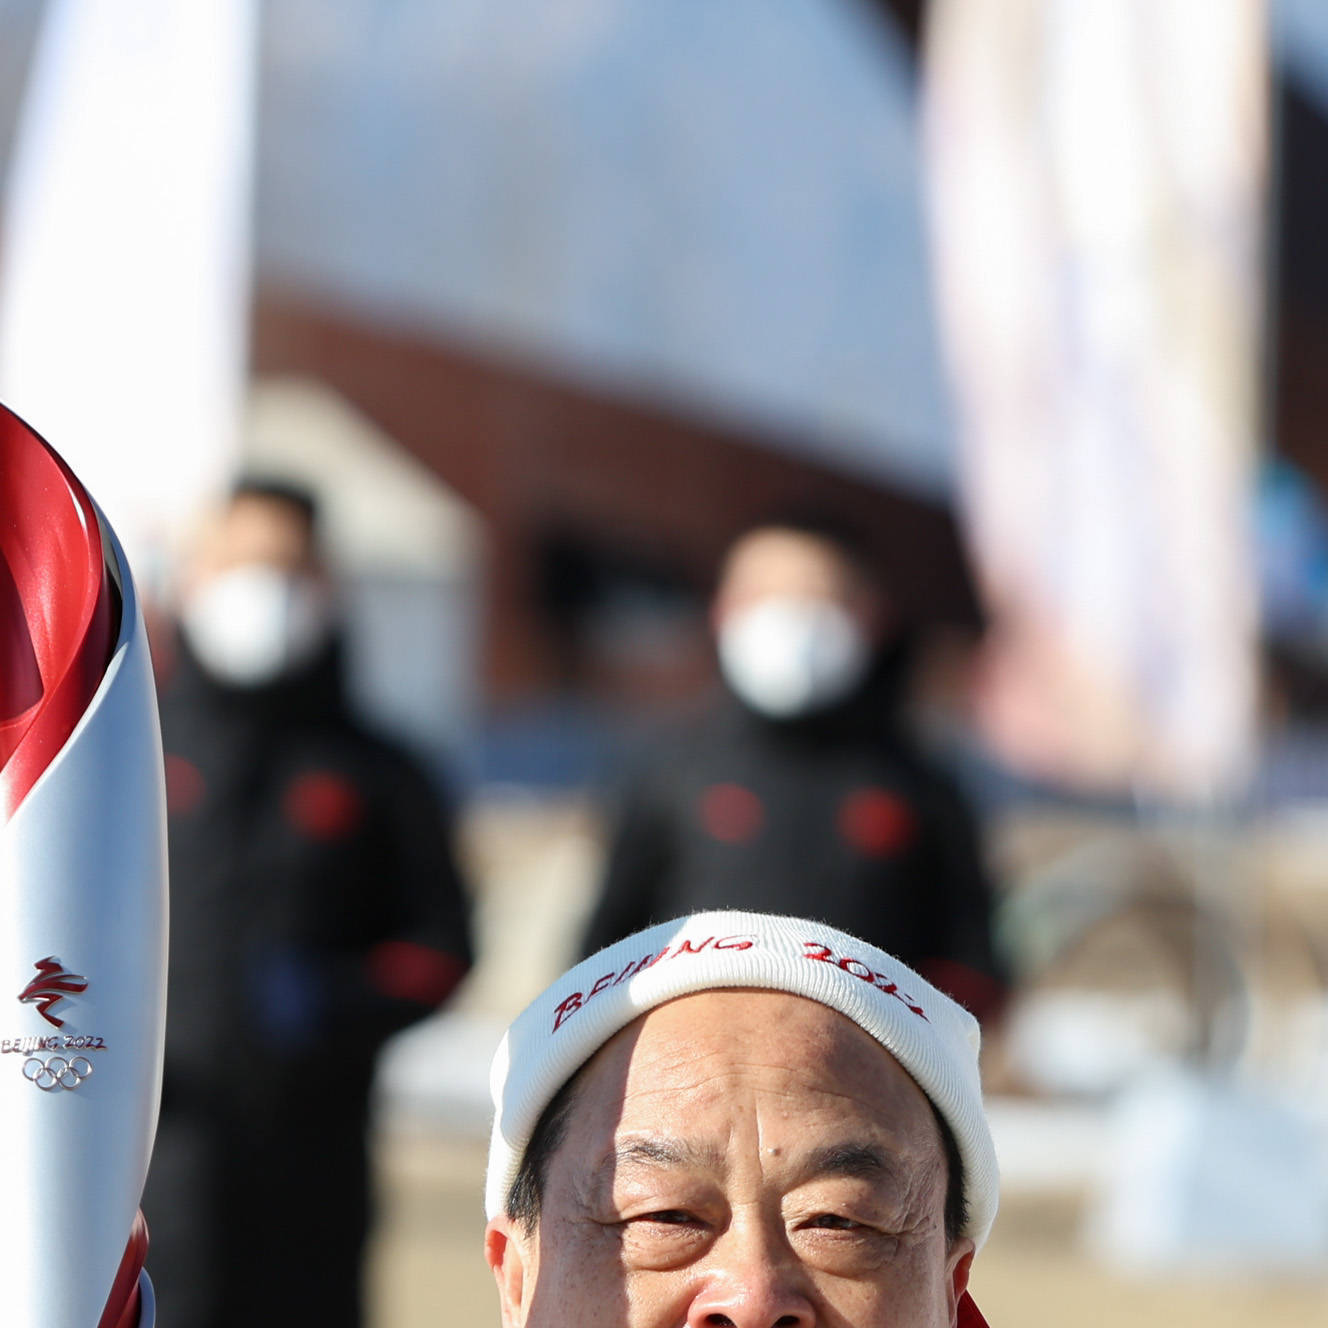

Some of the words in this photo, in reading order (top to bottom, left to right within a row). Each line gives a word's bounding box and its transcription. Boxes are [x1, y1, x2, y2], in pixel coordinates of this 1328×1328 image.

[552, 934, 758, 1034] BEIJING
[803, 942, 930, 1023] 2022
[1, 1036, 58, 1054] BEIJING
[63, 1035, 107, 1050] 2022
